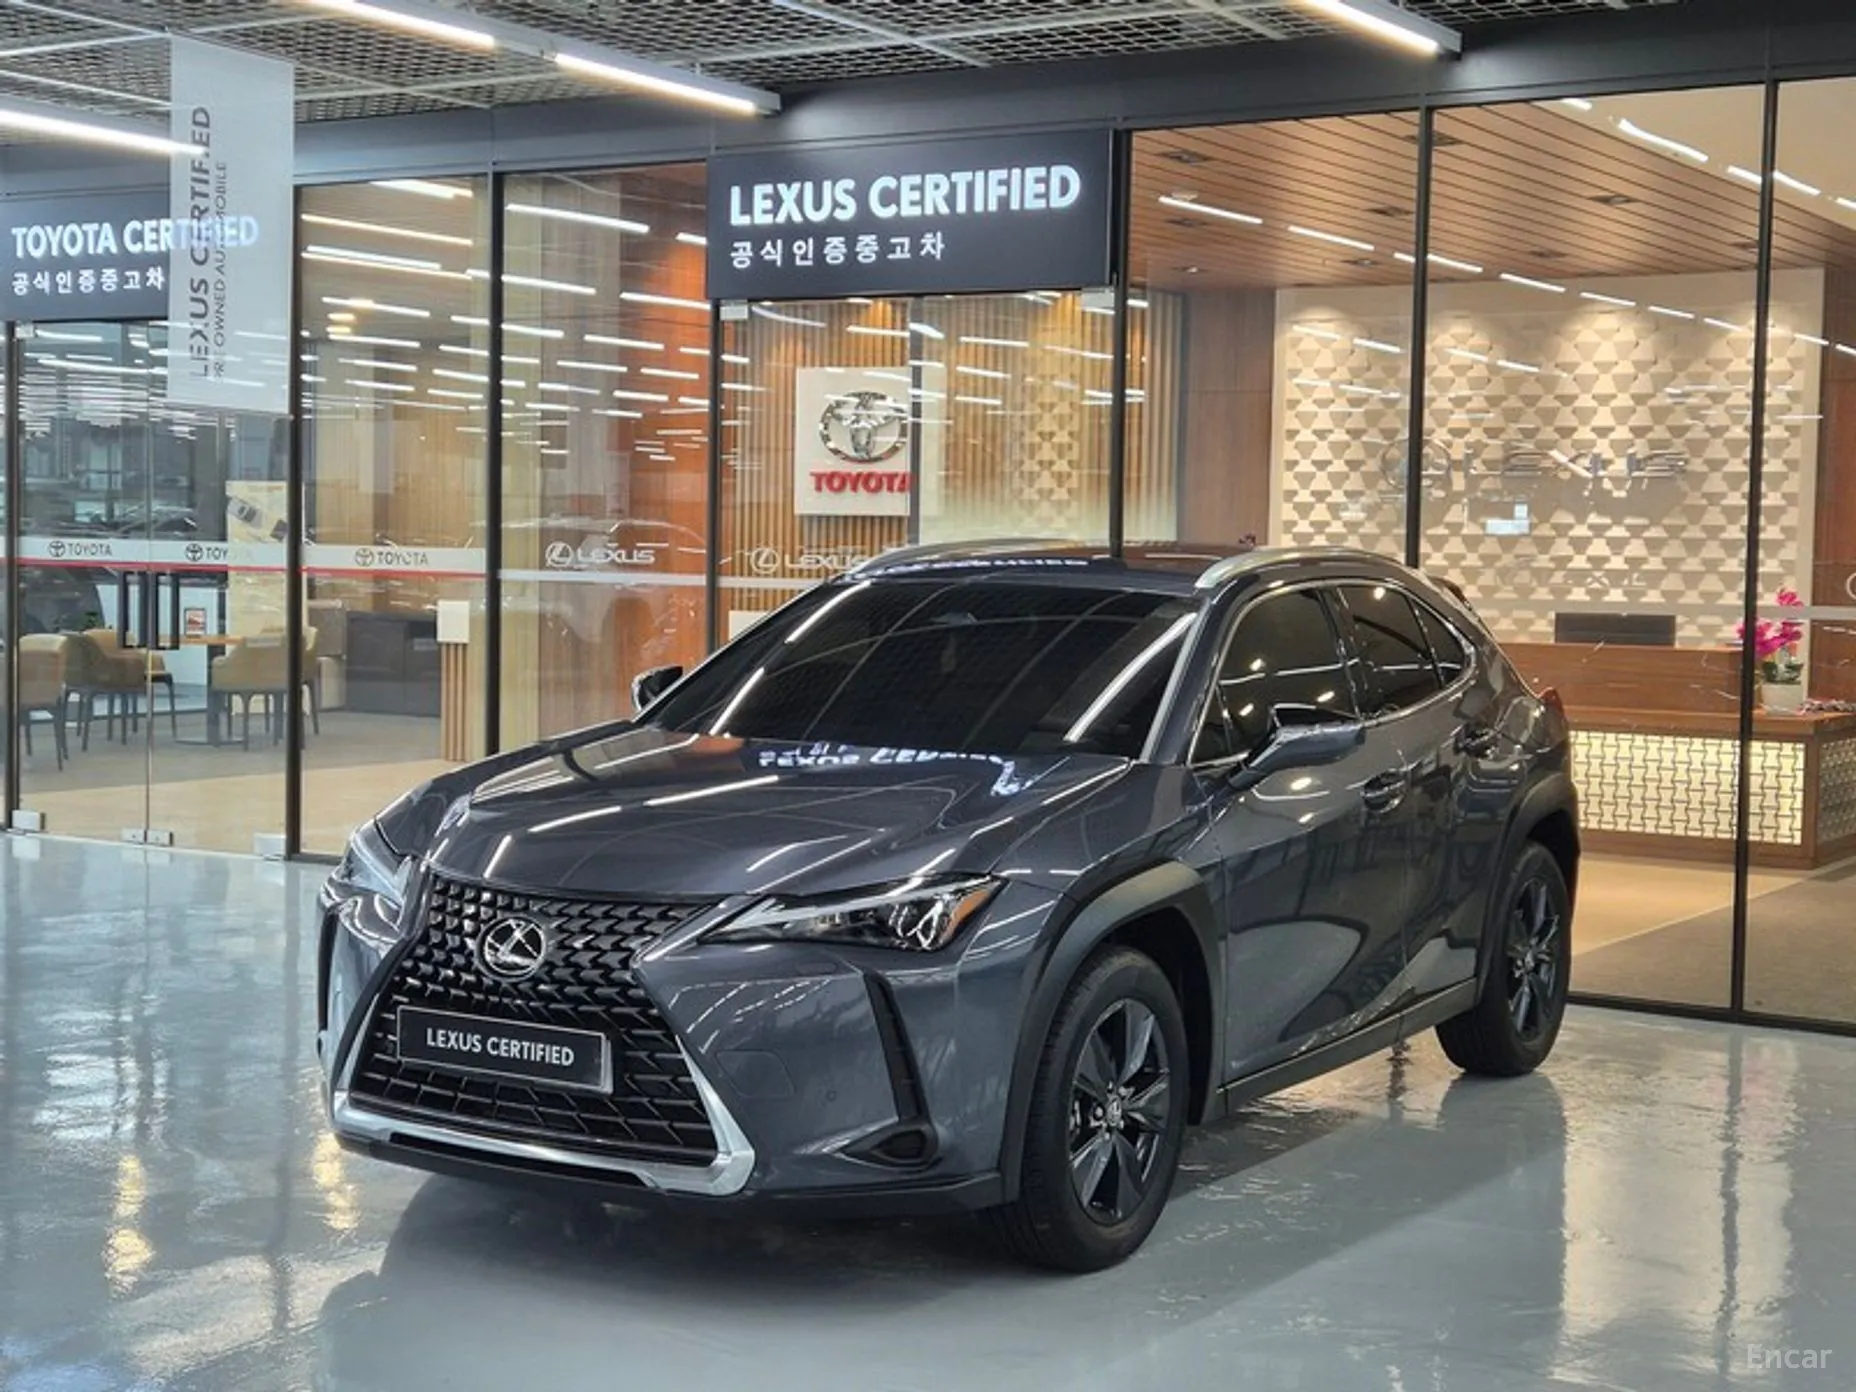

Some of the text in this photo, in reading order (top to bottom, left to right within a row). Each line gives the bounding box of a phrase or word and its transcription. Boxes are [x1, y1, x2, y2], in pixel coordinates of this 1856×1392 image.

[729, 163, 1082, 227] LEXUS CERTIFIED
[11, 221, 119, 259] TOYOTA
[189, 105, 211, 377] LEXUS CERTIFED
[729, 230, 946, 269] 공식인증중고차
[67, 543, 113, 557] TOYOTA
[377, 551, 429, 567] TOYOTA
[576, 547, 656, 566] LEXUS
[426, 1027, 575, 1067] LEXUS CERTIFIED
